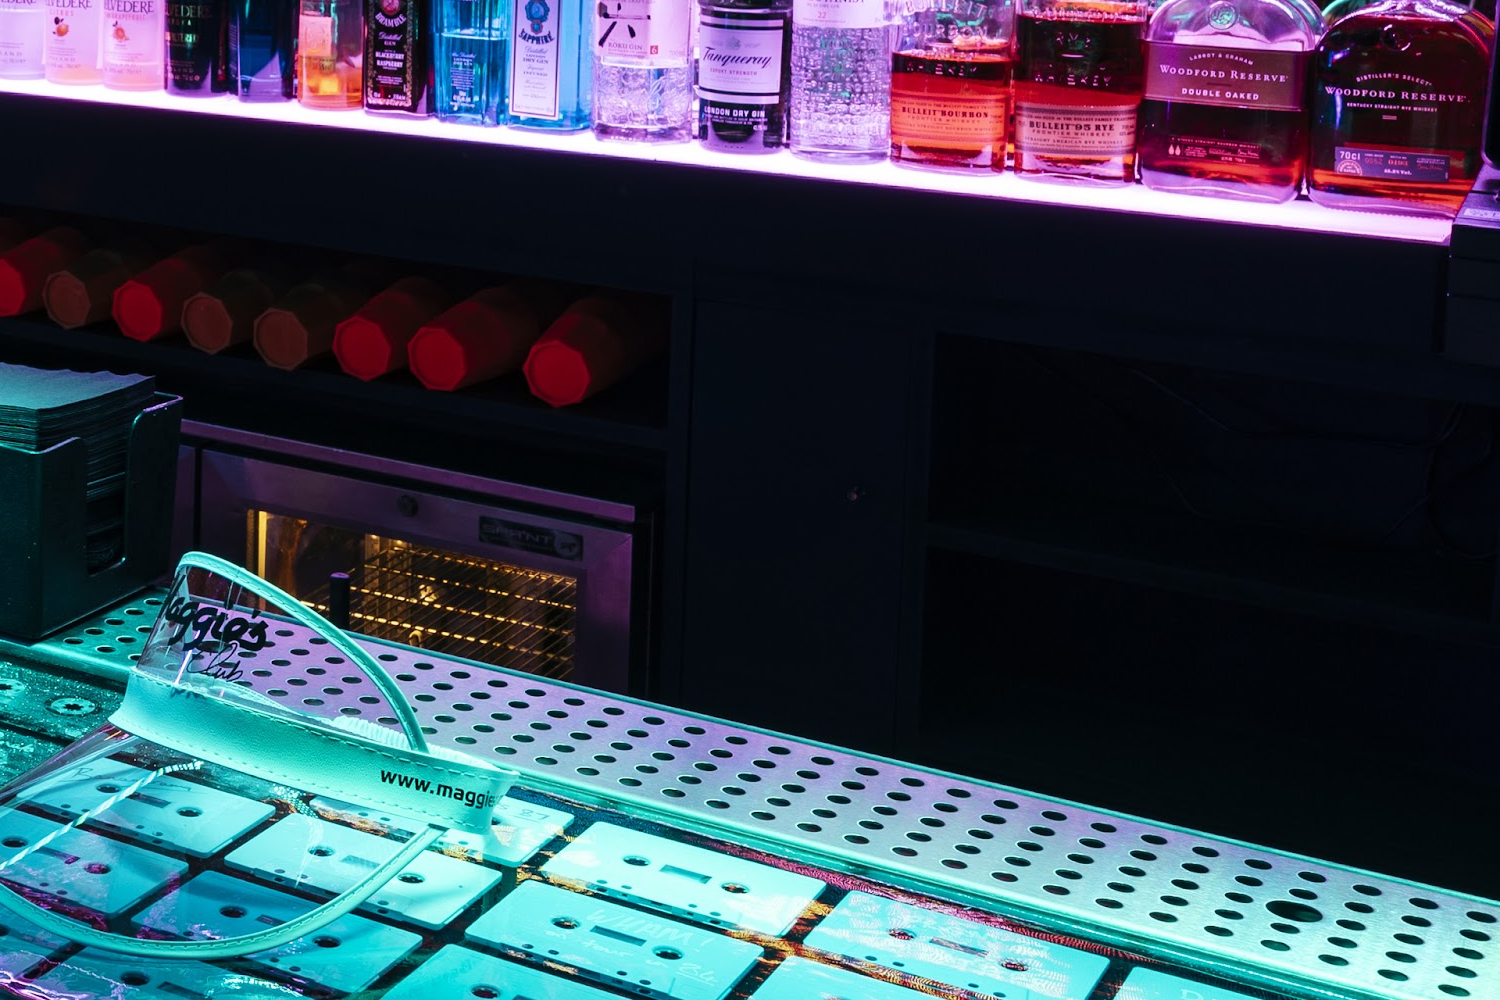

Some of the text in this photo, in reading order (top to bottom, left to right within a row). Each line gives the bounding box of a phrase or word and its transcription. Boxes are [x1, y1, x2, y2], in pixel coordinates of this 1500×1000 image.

[375, 13, 407, 28] BRAMBLE
[518, 28, 555, 45] SAPPHIRE
[375, 51, 405, 60] BLACKBERRY
[702, 46, 773, 70] Tanqueray
[376, 60, 404, 69] RASPBERRY
[1159, 64, 1287, 83] WOODFORD RESERVE
[1356, 72, 1430, 87] DISTILLER'S SELECT
[1181, 87, 1260, 100] DOUBLE OAKED
[1325, 86, 1465, 103] WOODFORD RESERVE
[704, 105, 766, 118] LONDON DRY GIN
[902, 106, 990, 118] BULLEIT BOURBON
[1029, 121, 1115, 131] BULLEIT 95 RYE
[164, 597, 270, 652] aggie's
[187, 642, 244, 683] Club
